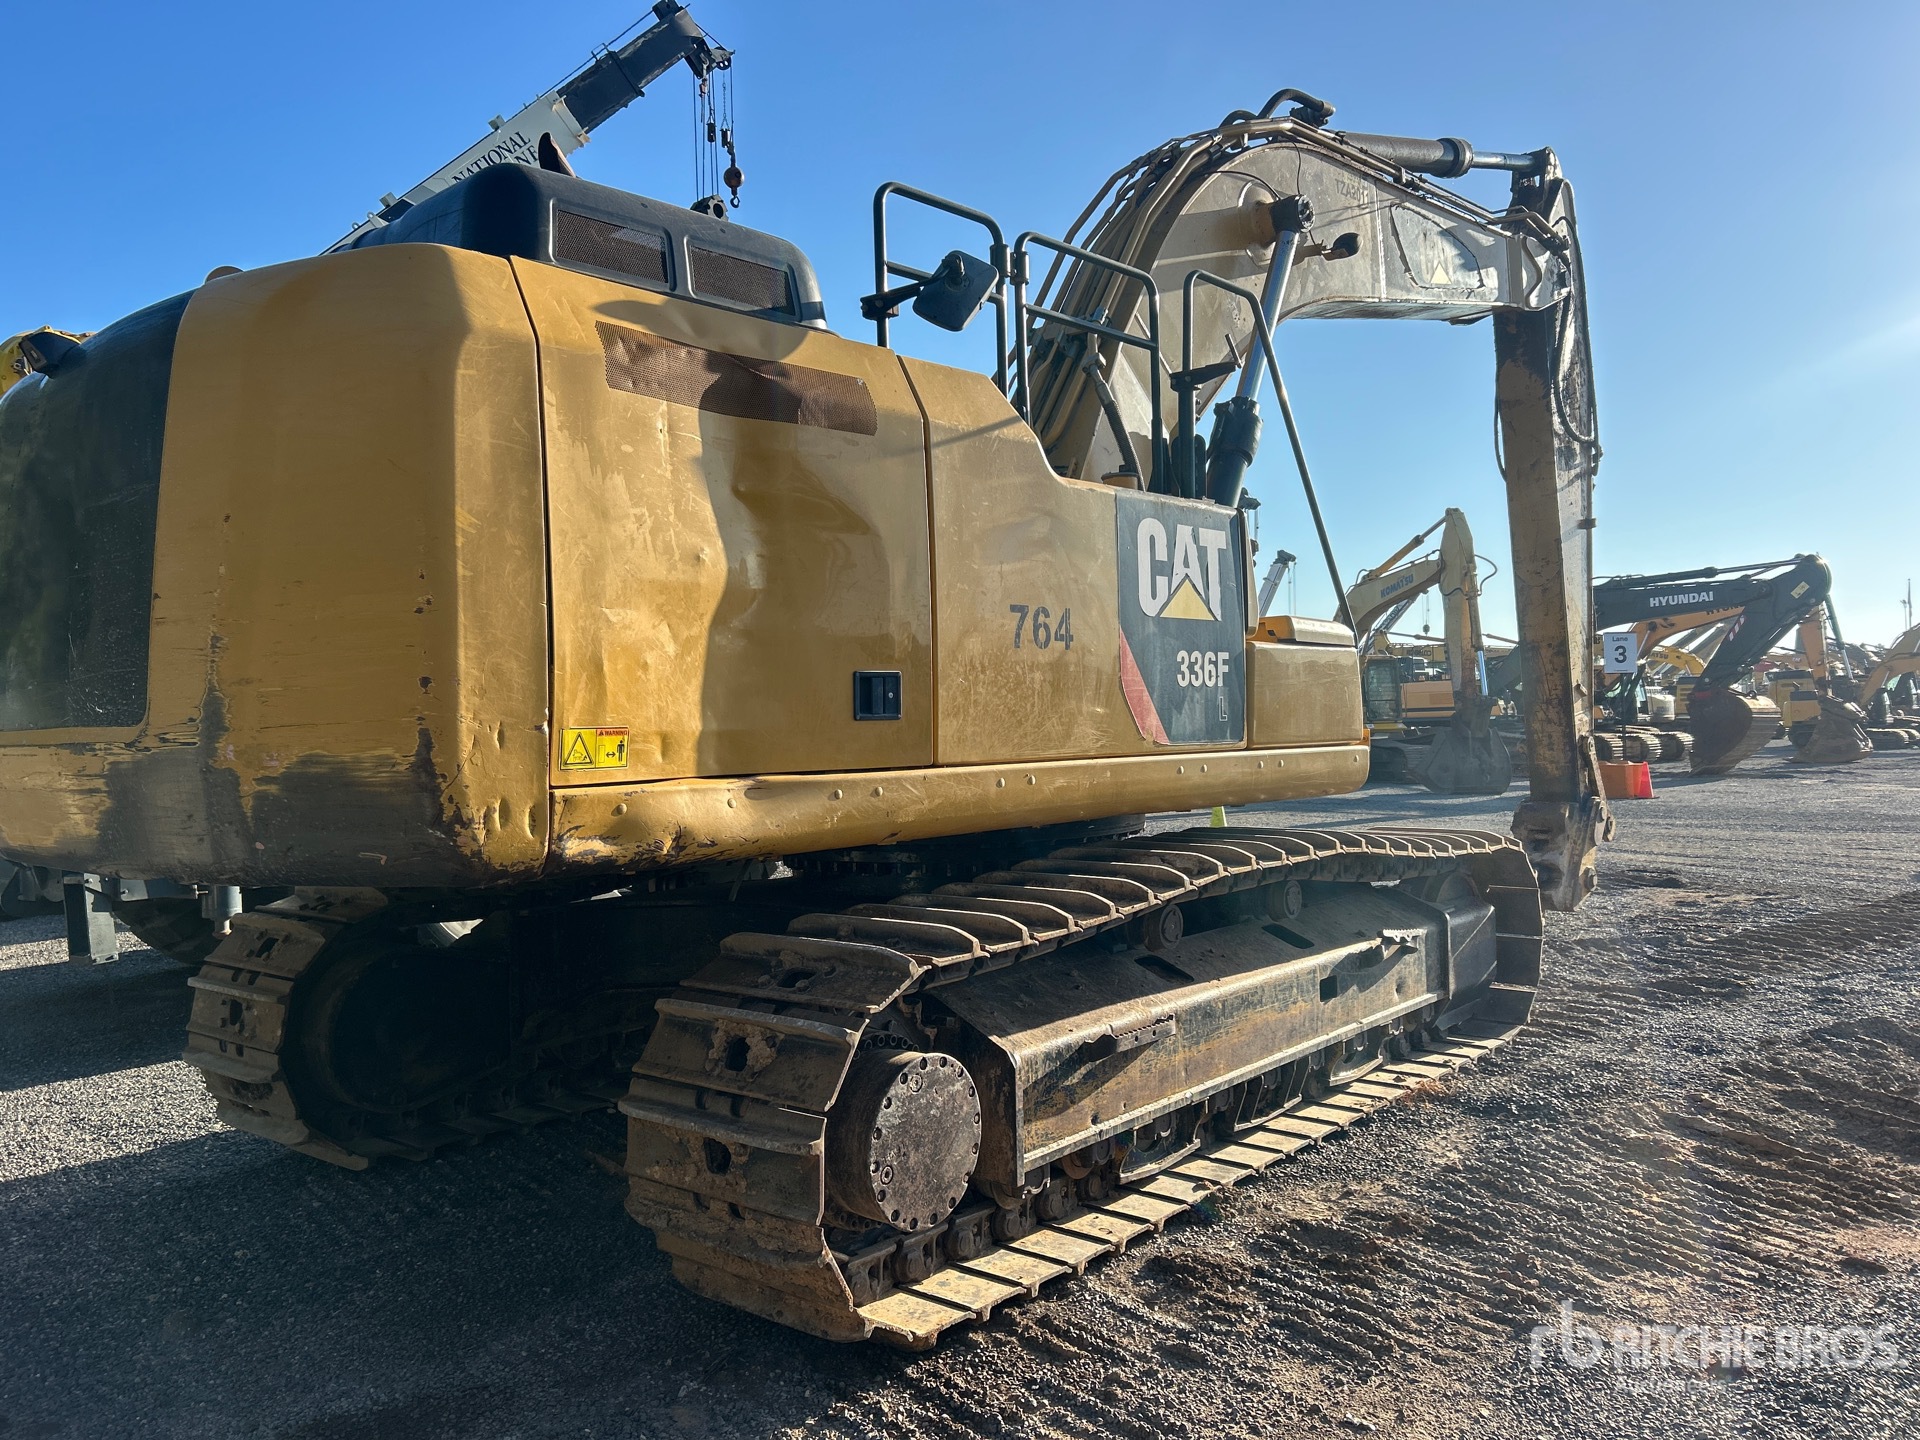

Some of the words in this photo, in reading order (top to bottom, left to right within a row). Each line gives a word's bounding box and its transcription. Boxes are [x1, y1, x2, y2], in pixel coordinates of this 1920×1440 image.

[1137, 517, 1227, 622] CAT
[1380, 573, 1414, 599] KOMATSU
[1650, 591, 1714, 608] HYUNDAI
[1009, 604, 1074, 650] 764
[1614, 645, 1627, 664] 3
[1176, 650, 1229, 688] 336F
[1218, 696, 1228, 722] L
